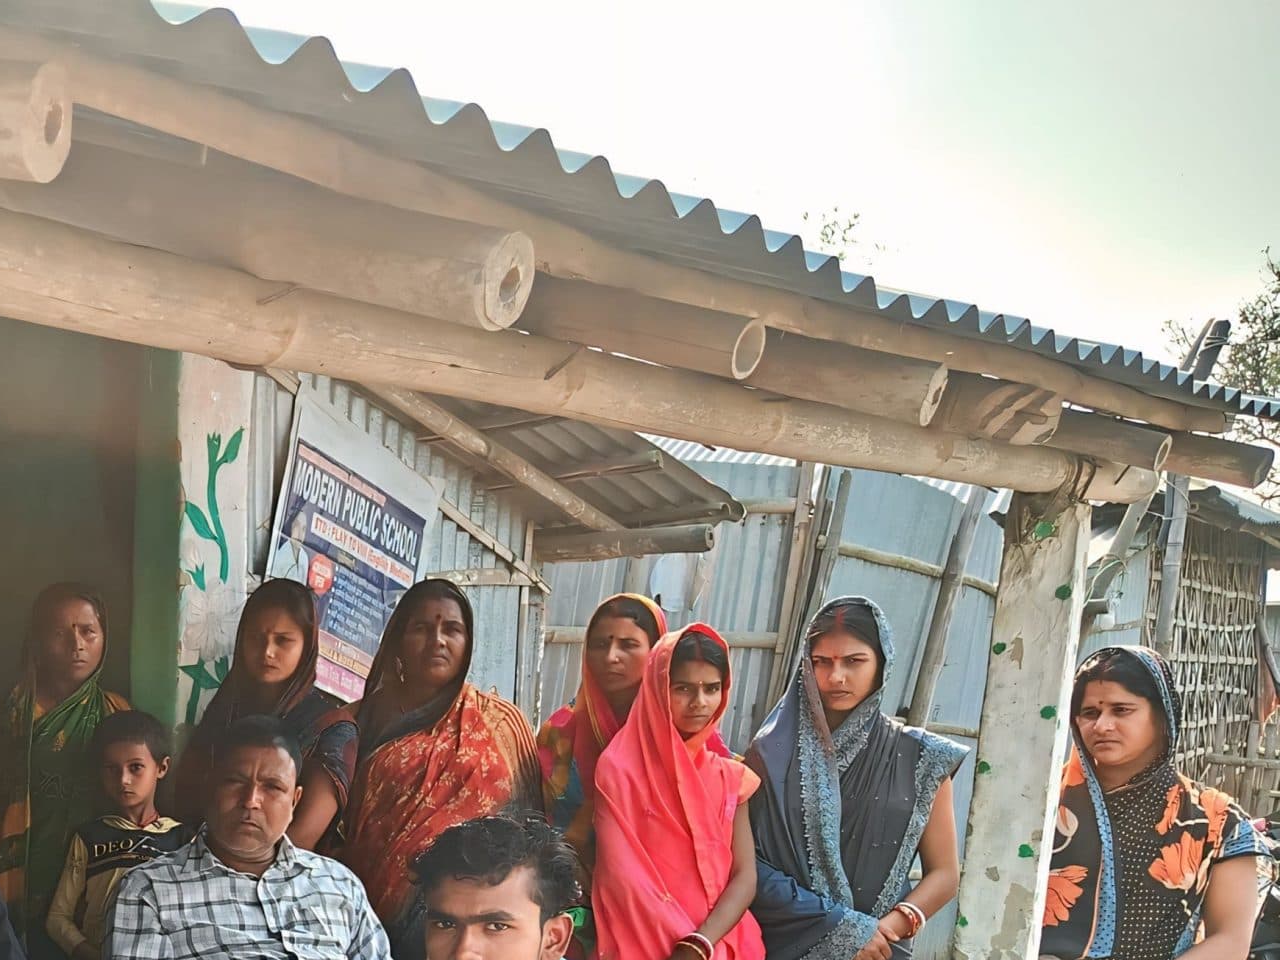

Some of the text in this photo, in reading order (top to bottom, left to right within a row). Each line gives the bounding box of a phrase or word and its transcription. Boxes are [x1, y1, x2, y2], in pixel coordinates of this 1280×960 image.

[293, 460, 343, 518] MODERN
[342, 489, 381, 541] PUBLIC
[380, 513, 418, 566] SCHOOL
